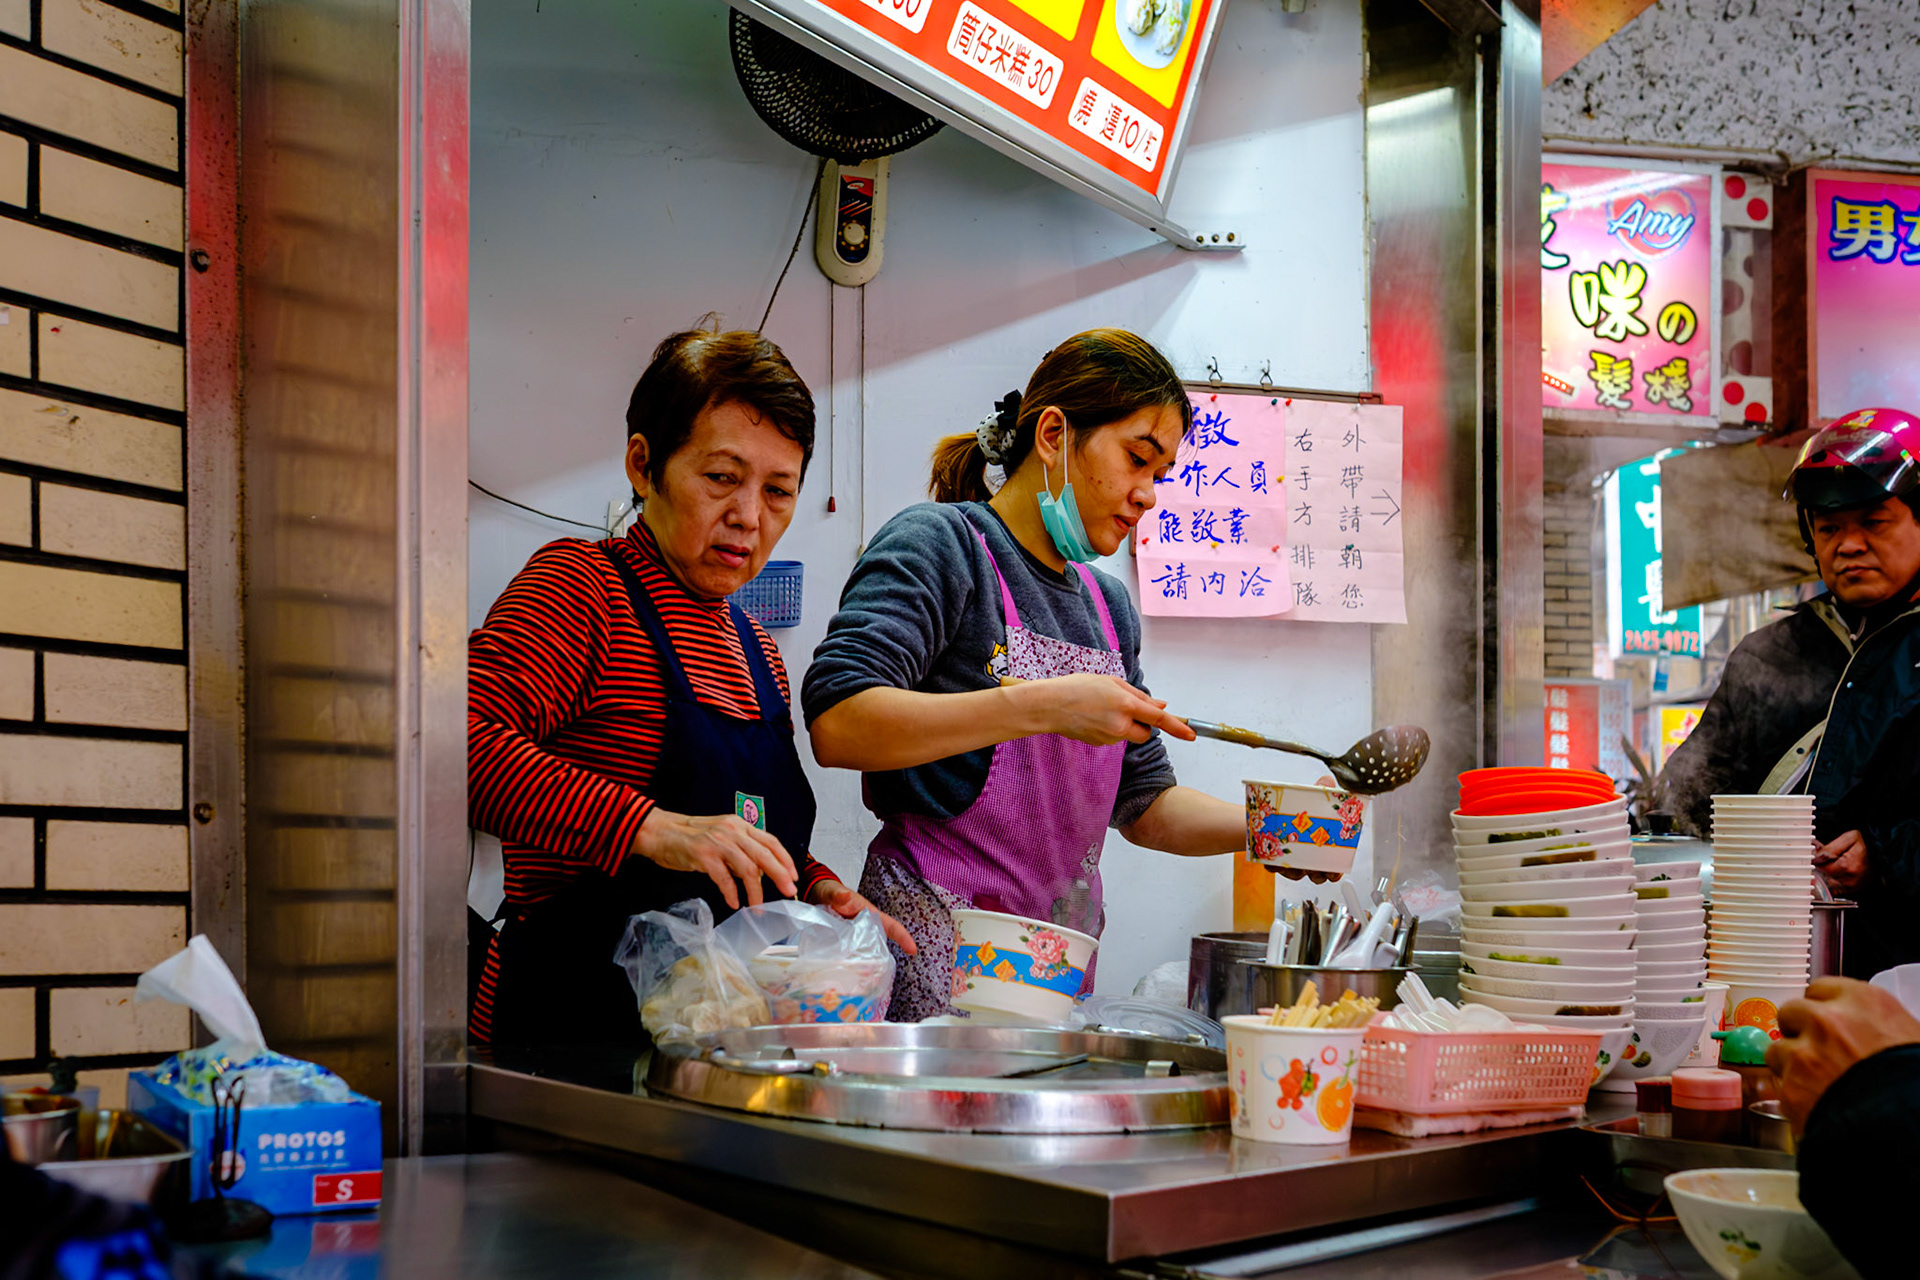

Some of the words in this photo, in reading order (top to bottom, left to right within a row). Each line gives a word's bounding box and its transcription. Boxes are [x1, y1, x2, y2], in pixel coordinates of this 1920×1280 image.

[953, 10, 1054, 97] 筒仔米糕30
[1607, 199, 1696, 250] Amy
[1158, 508, 1250, 545] 能敬業
[1290, 428, 1322, 608] 右手方排隊
[258, 1130, 346, 1149] PROTOS
[335, 1178, 354, 1201] S
